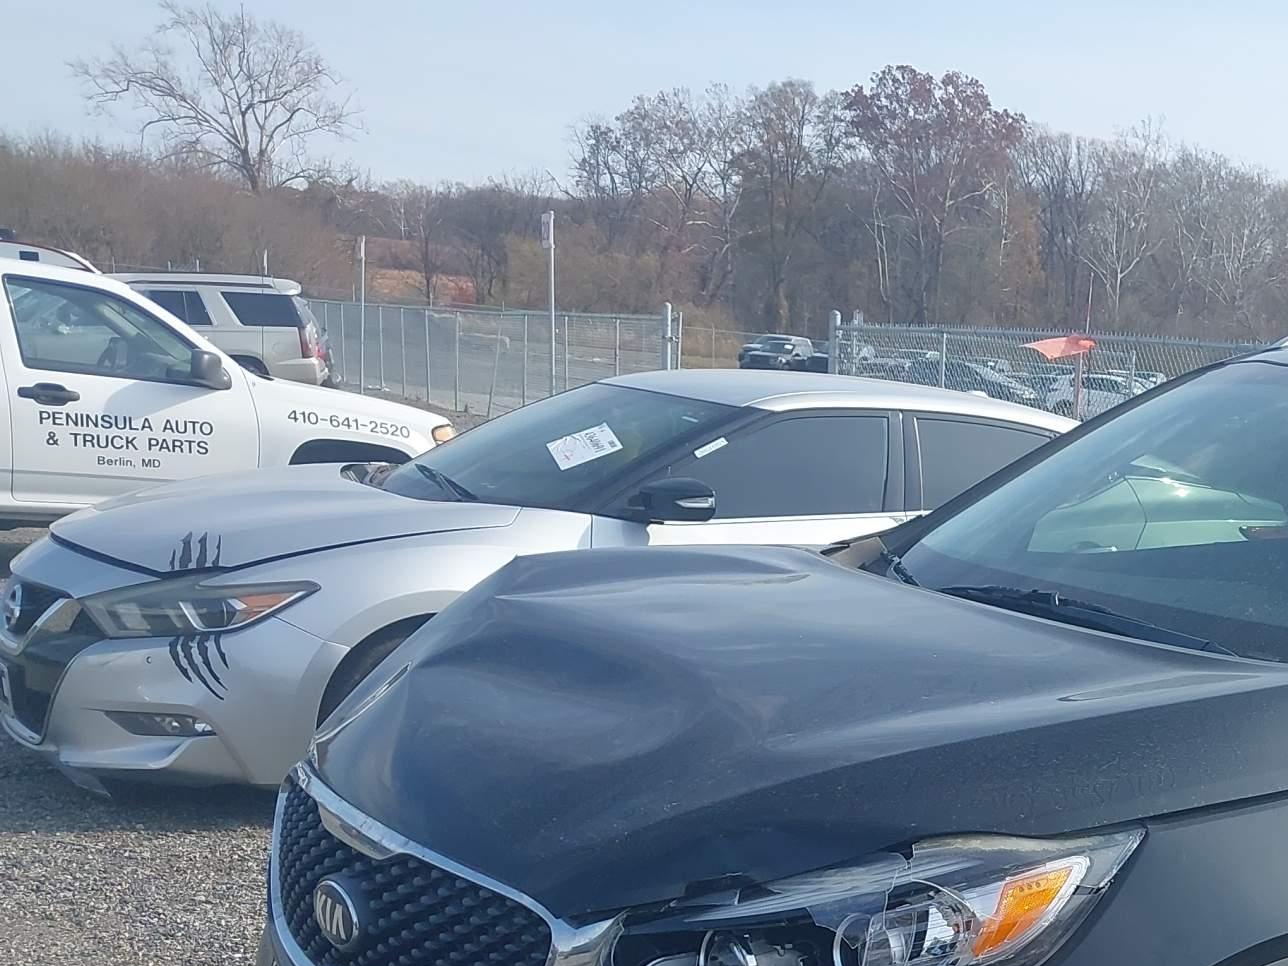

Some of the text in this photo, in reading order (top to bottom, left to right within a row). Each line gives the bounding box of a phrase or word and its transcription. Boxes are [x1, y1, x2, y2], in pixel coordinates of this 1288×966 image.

[39, 410, 214, 436] PENINSULA AUTO
[287, 409, 410, 439] 410-641-2520
[46, 431, 209, 455] & TRUCK PARTS
[97, 455, 161, 469] Berlin, MD
[316, 889, 347, 941] KIA
